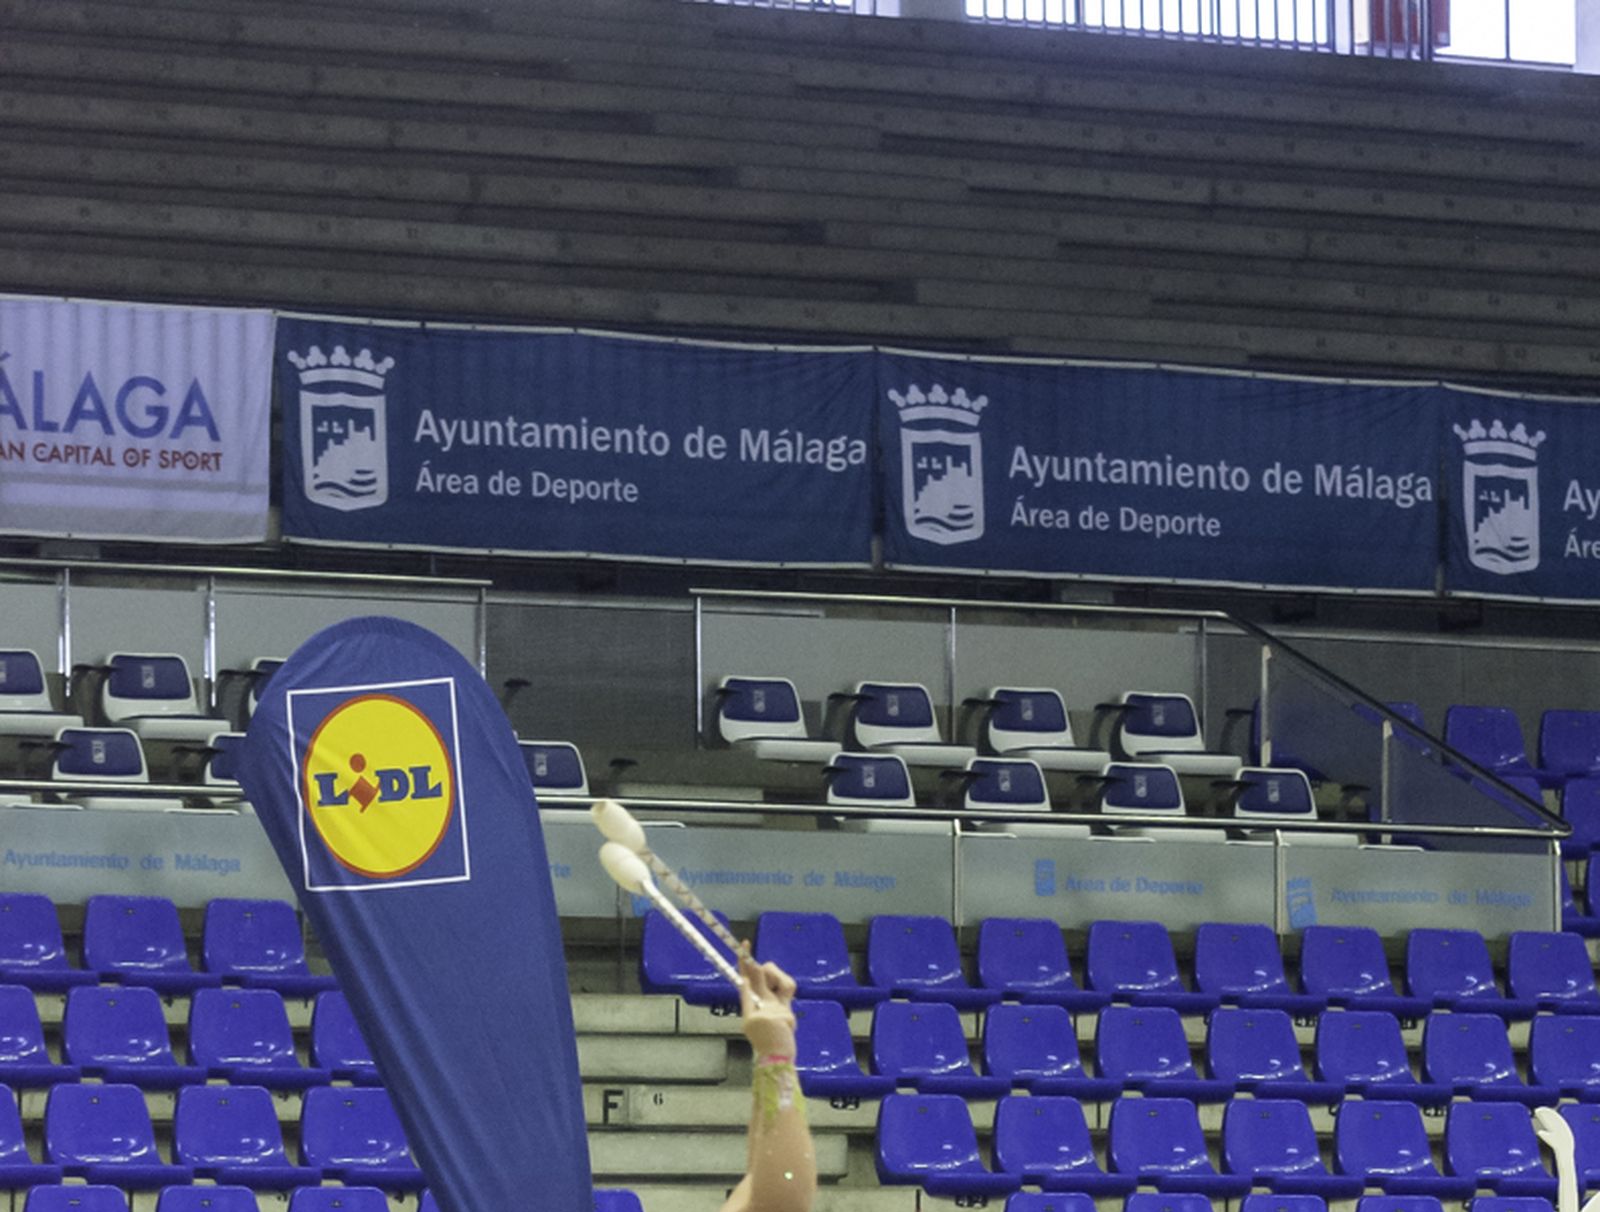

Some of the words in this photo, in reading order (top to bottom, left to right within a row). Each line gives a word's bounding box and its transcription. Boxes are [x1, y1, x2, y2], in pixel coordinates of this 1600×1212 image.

[32, 442, 116, 467] CAPITAL
[123, 447, 151, 468] OF
[158, 449, 223, 472] SPORT
[414, 408, 670, 457] Ayuntamiento
[683, 425, 728, 460] de
[739, 428, 867, 472] Málaga
[415, 459, 479, 495] Área
[487, 470, 521, 496] de
[531, 471, 639, 504] Deporte
[1008, 445, 1250, 492] Ayuntamiento
[1262, 461, 1304, 495] de
[1314, 463, 1433, 509] Málaga
[1010, 495, 1071, 529] Área
[1078, 505, 1110, 531] de
[1119, 506, 1222, 538] Deporte
[602, 1088, 624, 1126] F
